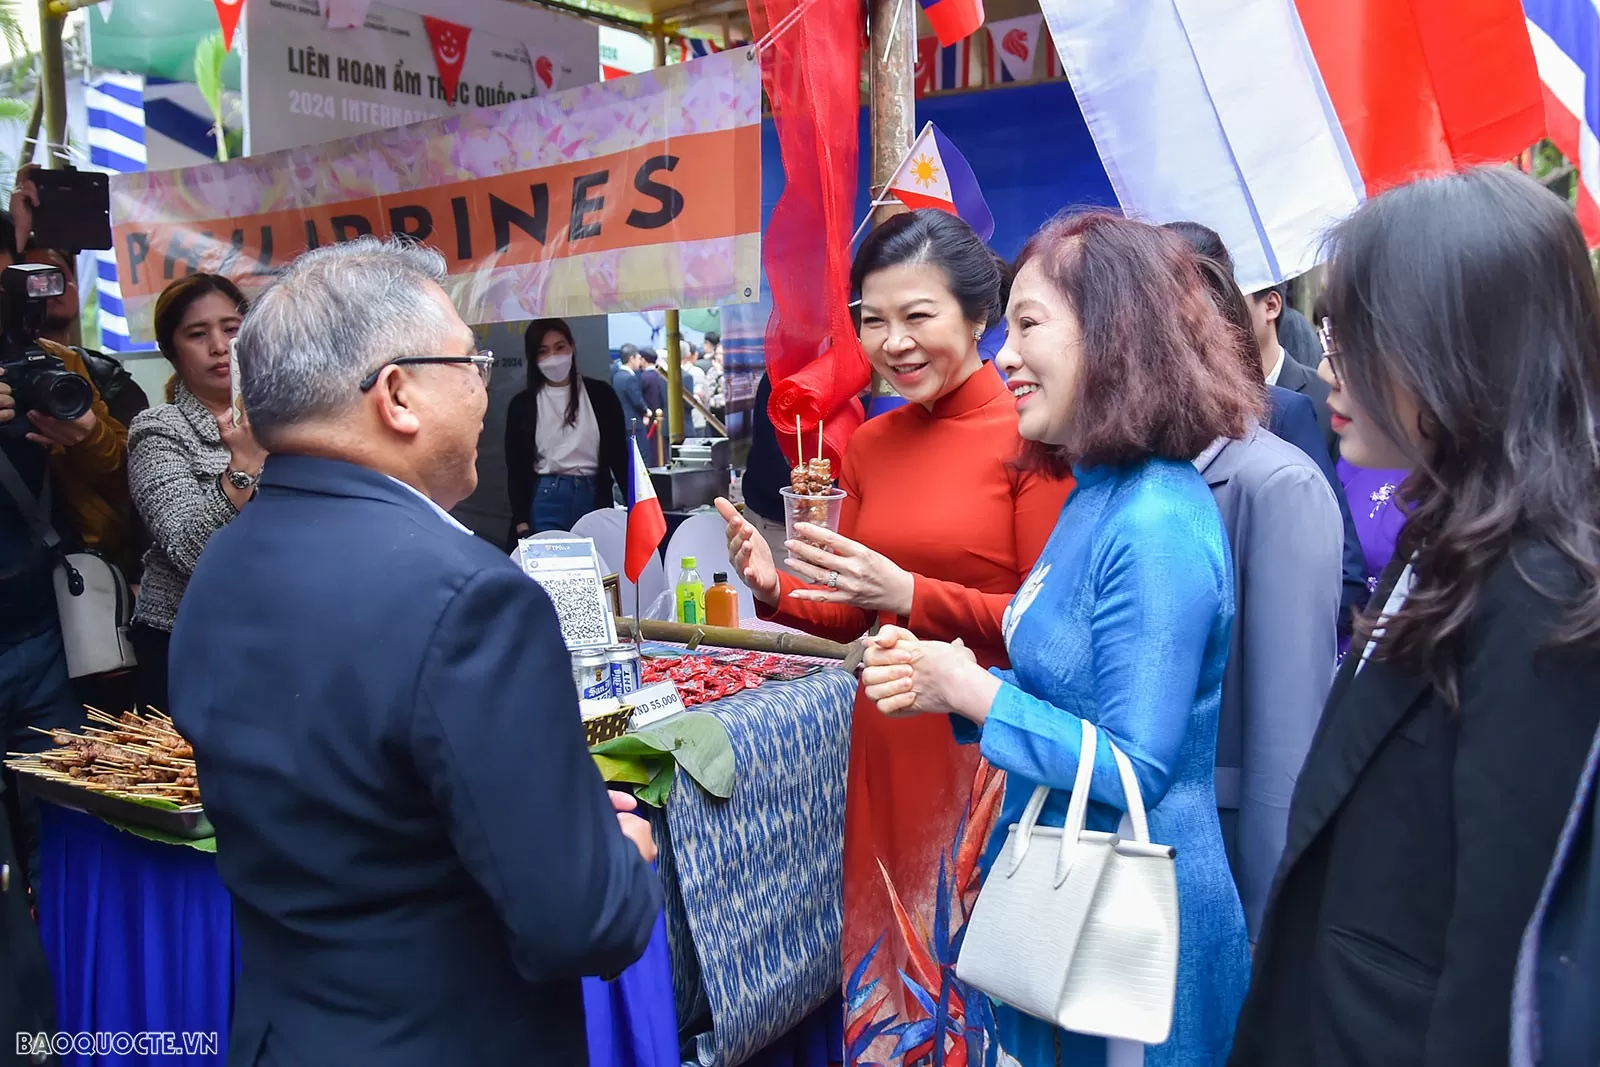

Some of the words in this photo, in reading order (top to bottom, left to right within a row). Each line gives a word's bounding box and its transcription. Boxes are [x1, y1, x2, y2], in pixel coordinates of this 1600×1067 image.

[288, 45, 330, 79] LIÊN
[337, 56, 387, 90] HOAN
[393, 58, 421, 96] ẨM
[288, 89, 336, 121] 2024
[624, 670, 632, 692] GHT
[650, 693, 677, 710] 55,000
